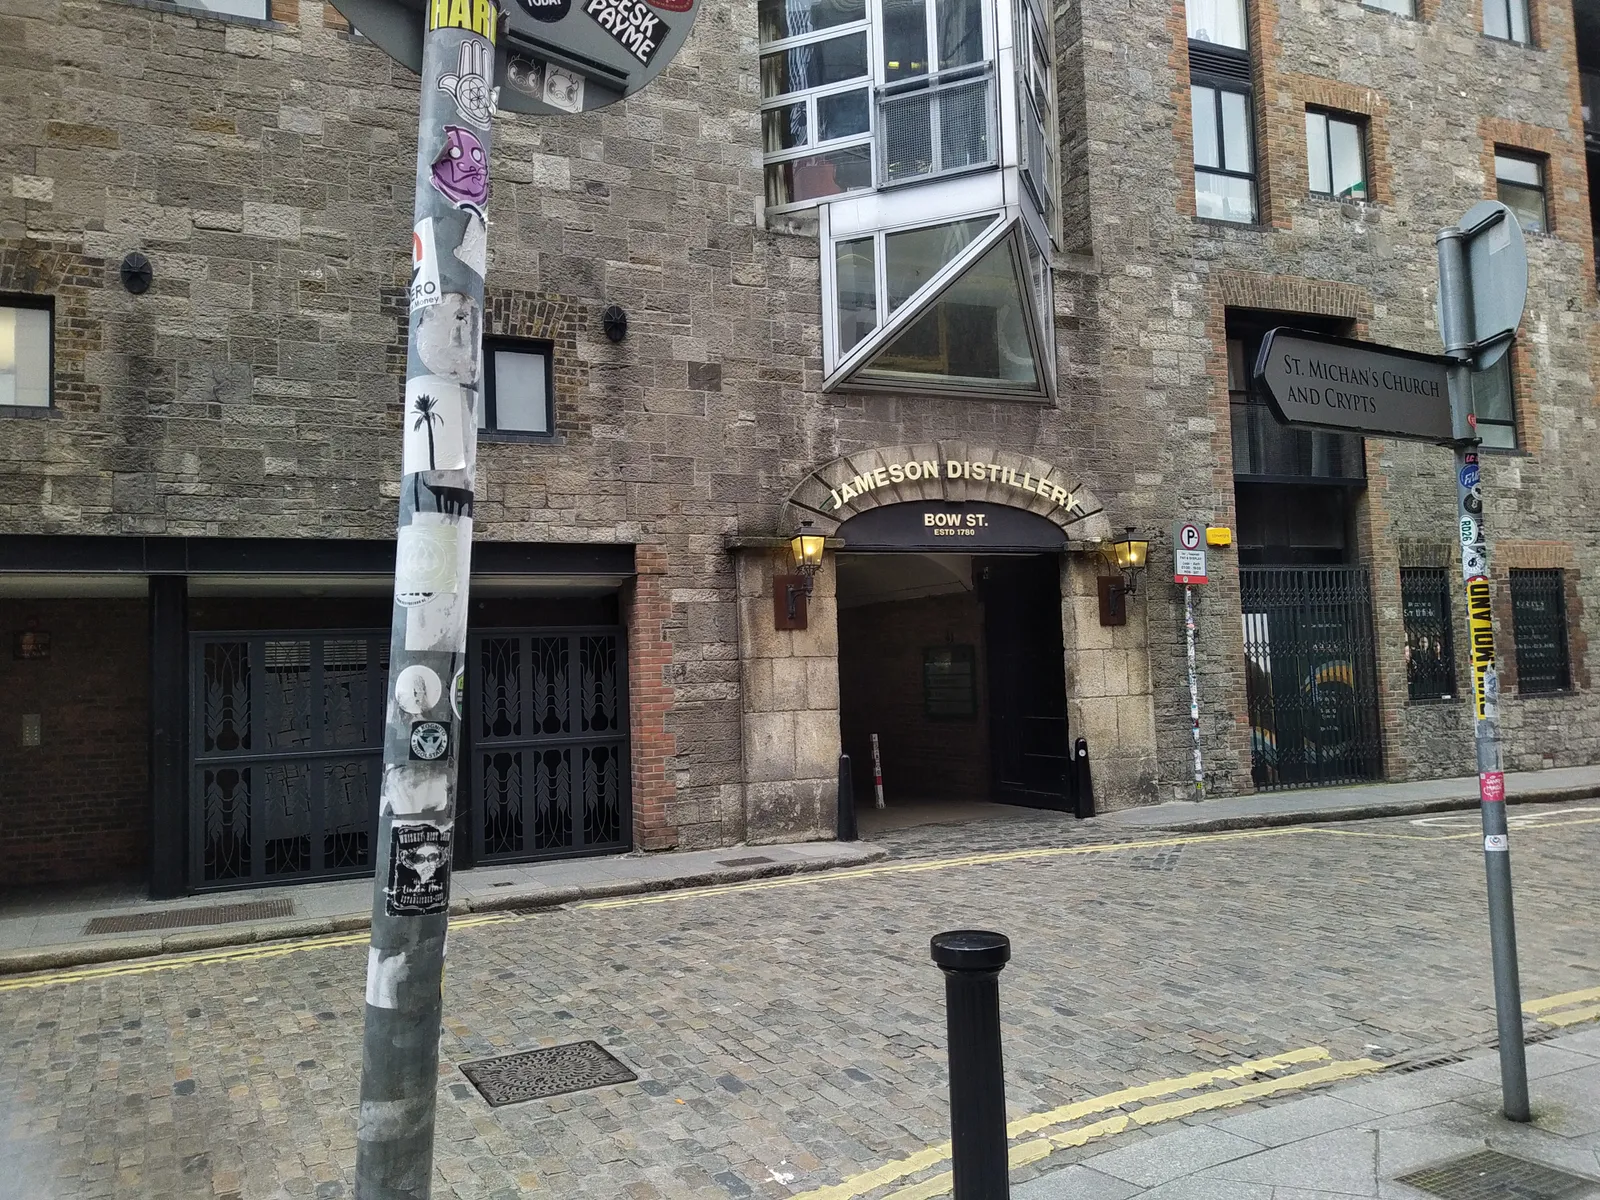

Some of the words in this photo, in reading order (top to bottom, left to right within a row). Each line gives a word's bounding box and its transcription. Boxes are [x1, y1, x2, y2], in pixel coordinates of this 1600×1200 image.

[1308, 359, 1379, 388] MICHAN'S
[1382, 371, 1440, 398] CHURCH
[1287, 384, 1320, 405] AND
[1324, 387, 1377, 414] CRYPTS
[831, 460, 939, 509] JAMESON
[947, 460, 1080, 513] DISTILLERY
[924, 513, 962, 527] BOW
[966, 513, 988, 527] ST.
[934, 528, 955, 536] ESTD
[1187, 529, 1195, 544] P
